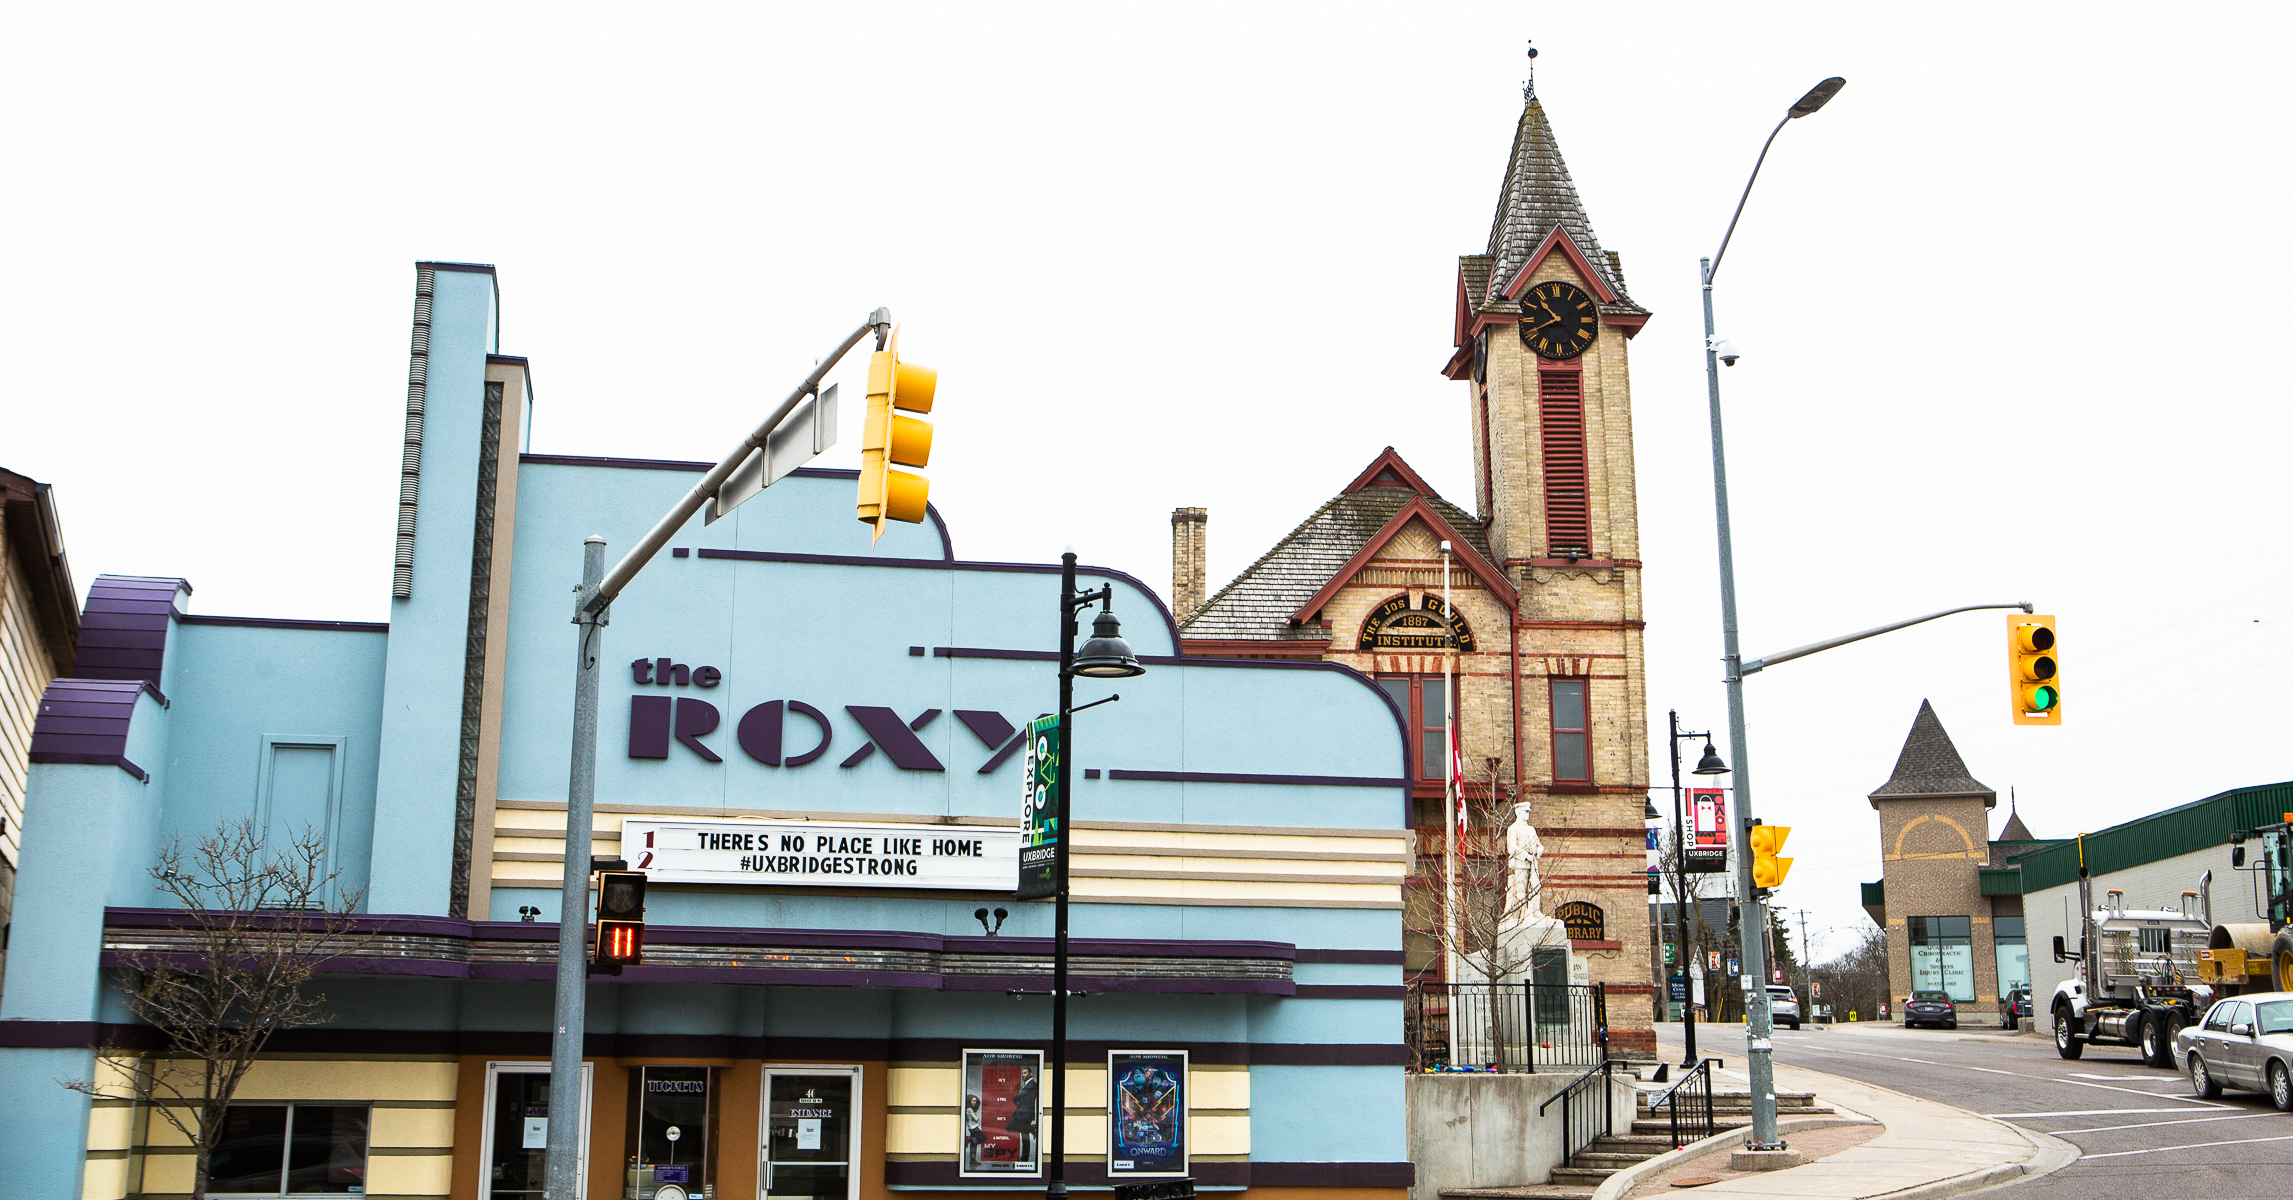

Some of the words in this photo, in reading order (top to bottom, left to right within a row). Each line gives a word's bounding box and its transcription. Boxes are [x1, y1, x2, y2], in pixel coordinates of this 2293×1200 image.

[1362, 618, 1381, 642] THE
[1384, 600, 1406, 616] JOS
[1428, 600, 1470, 643] GOULD
[1402, 616, 1429, 627] 1887
[631, 658, 722, 687] the
[629, 695, 1055, 774] ROXY
[1022, 755, 1034, 844] EXPLORE
[643, 830, 655, 849] 1
[1685, 819, 1694, 847] SHOP
[780, 835, 805, 852] NO
[817, 836, 873, 855] PLACE
[883, 837, 923, 856] LIKE
[932, 839, 983, 857] HOME
[1023, 847, 1055, 862] UXBRIDGE
[637, 851, 654, 869] 2
[740, 855, 917, 876] #UXBRIDGESTRONG
[1557, 903, 1601, 924] PUBLIC
[1567, 927, 1602, 939] BRARY
[648, 1080, 704, 1092] TICKETS
[789, 1109, 832, 1117] ENTRANCE
[984, 1149, 1017, 1158] SPY
[1130, 1147, 1167, 1157] ONWARD
